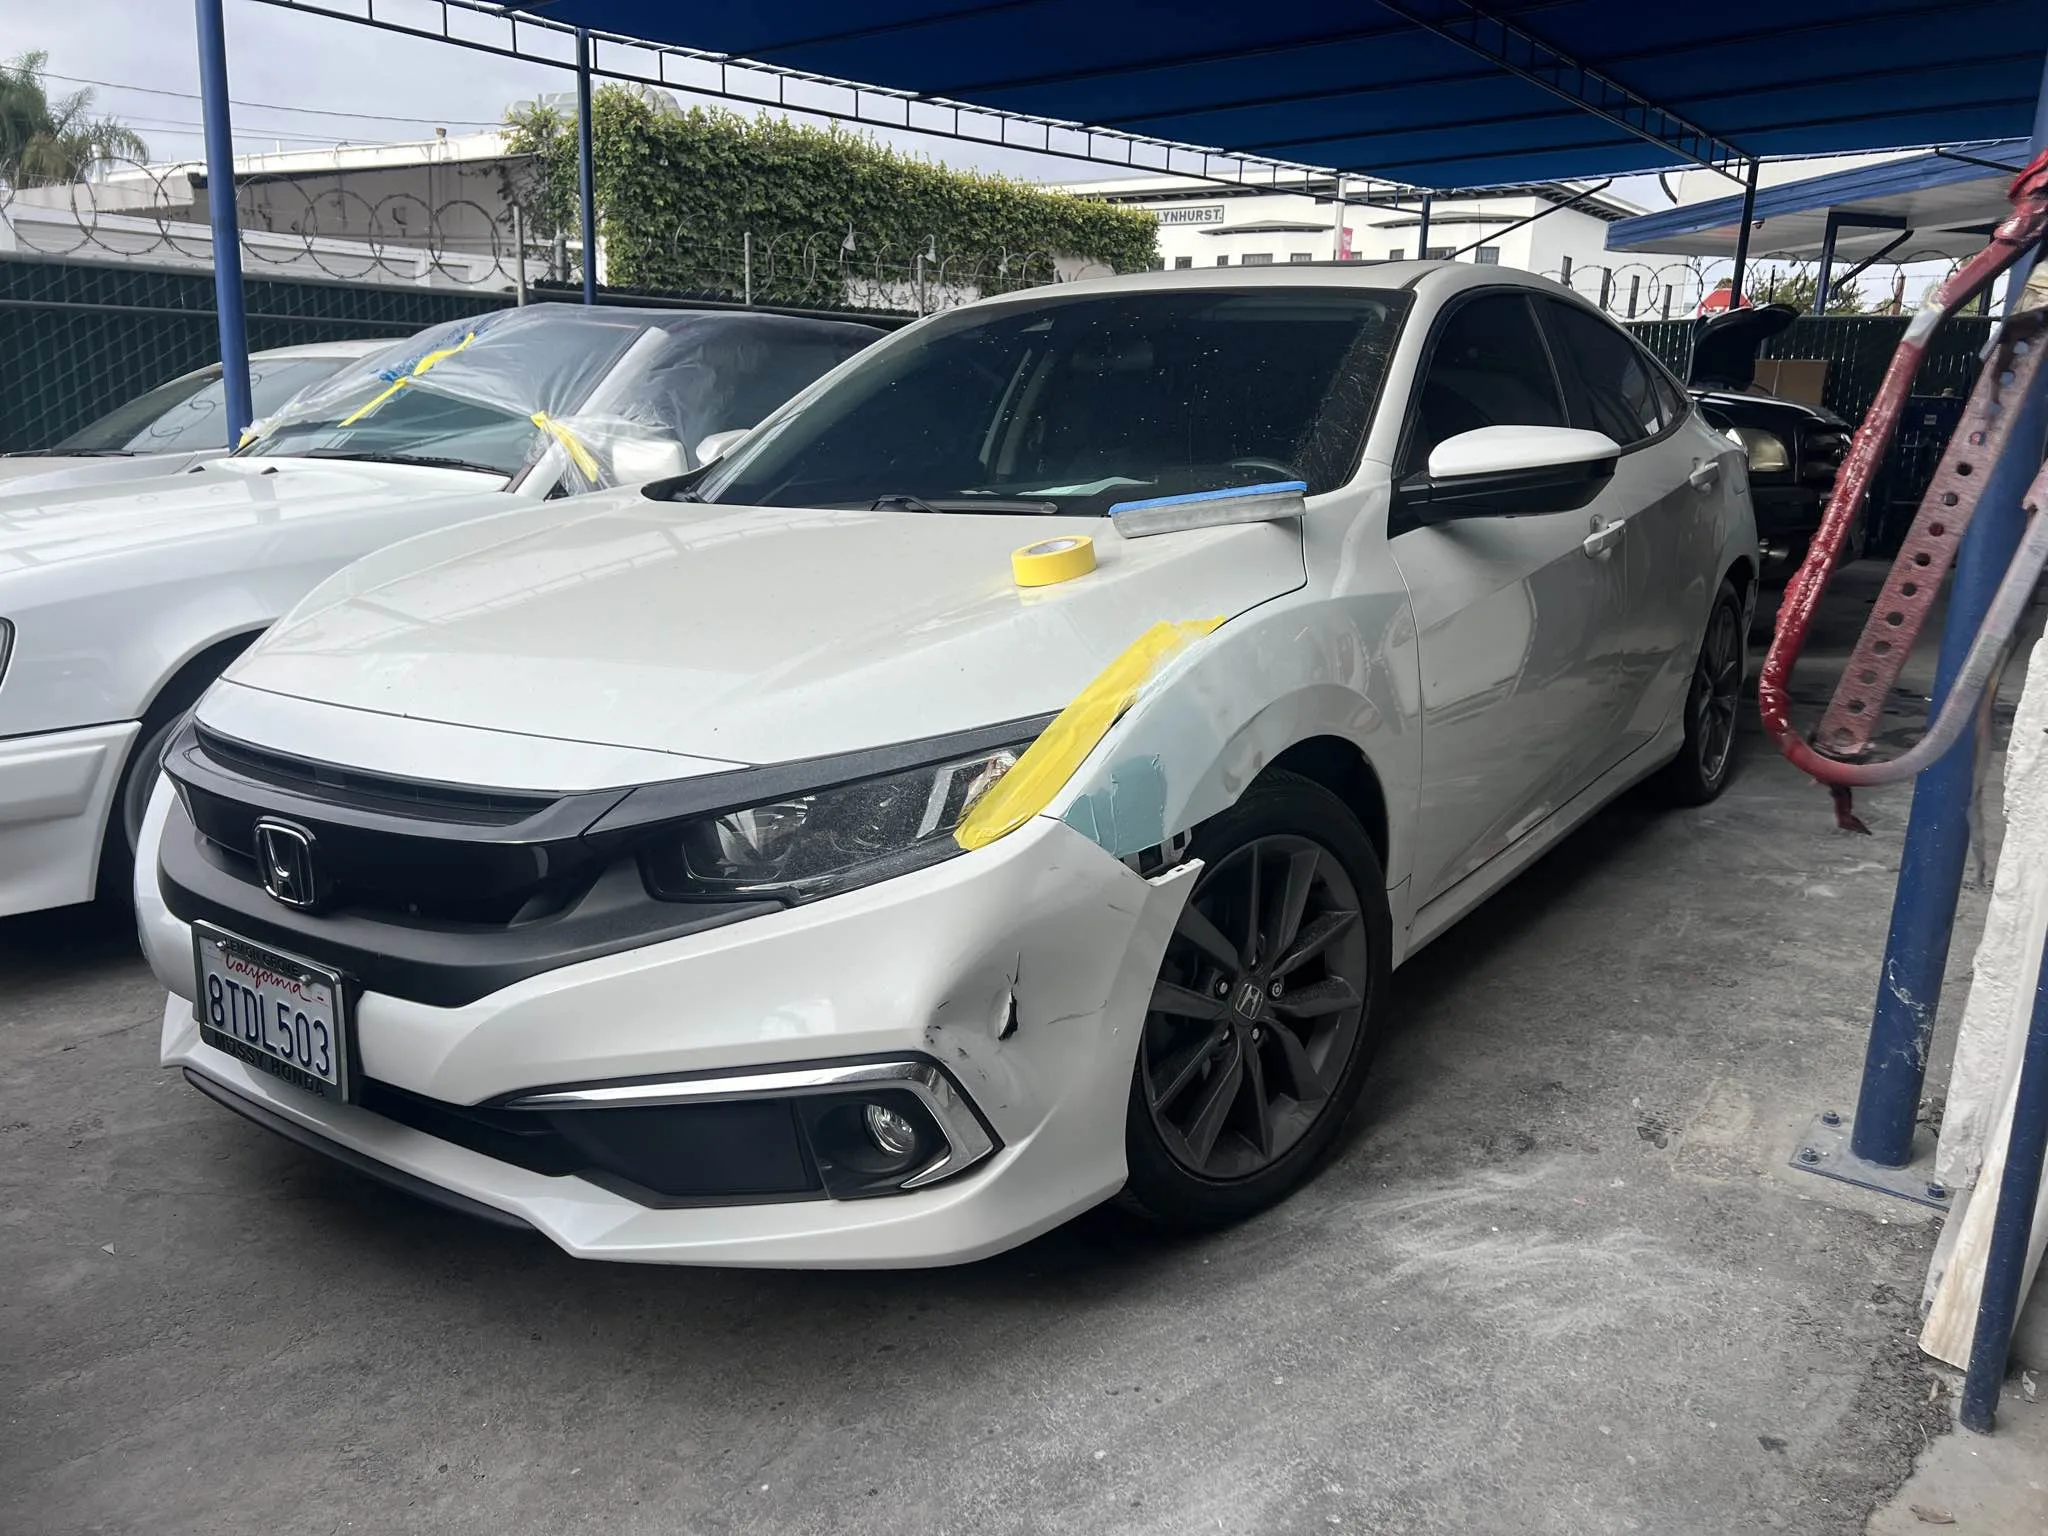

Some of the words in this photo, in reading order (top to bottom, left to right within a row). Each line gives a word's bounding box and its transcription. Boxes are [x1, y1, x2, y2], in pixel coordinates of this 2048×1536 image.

[226, 953, 312, 1002] California
[263, 953, 300, 976] GROVE
[208, 973, 331, 1077] 8TDL503
[215, 1031, 264, 1068] MOSSY
[271, 1058, 325, 1096] HONDA
